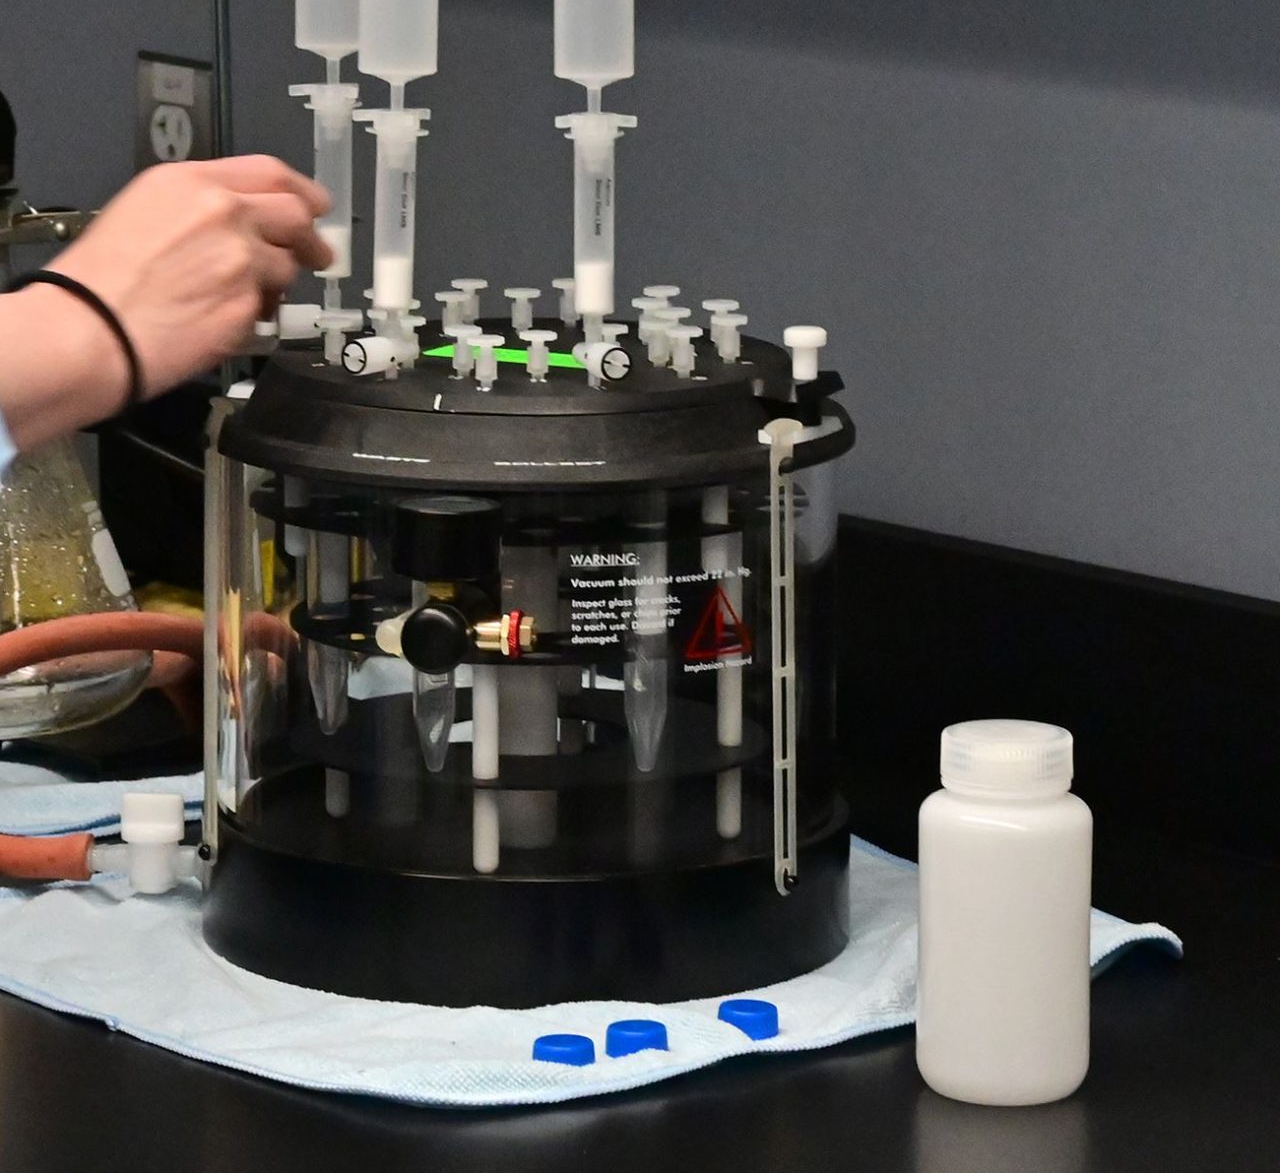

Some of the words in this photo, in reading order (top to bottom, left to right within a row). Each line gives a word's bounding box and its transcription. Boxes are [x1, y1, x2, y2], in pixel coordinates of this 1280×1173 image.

[570, 552, 641, 567] WARNING:
[570, 578, 616, 589] Vacuum
[617, 575, 655, 587] should
[655, 575, 674, 585] not
[675, 570, 709, 583] exceed
[571, 598, 607, 610] Inspect
[607, 597, 634, 610] glass
[620, 610, 632, 619] or
[571, 623, 582, 633] to
[583, 621, 608, 632] each
[571, 633, 620, 646] damaged.
